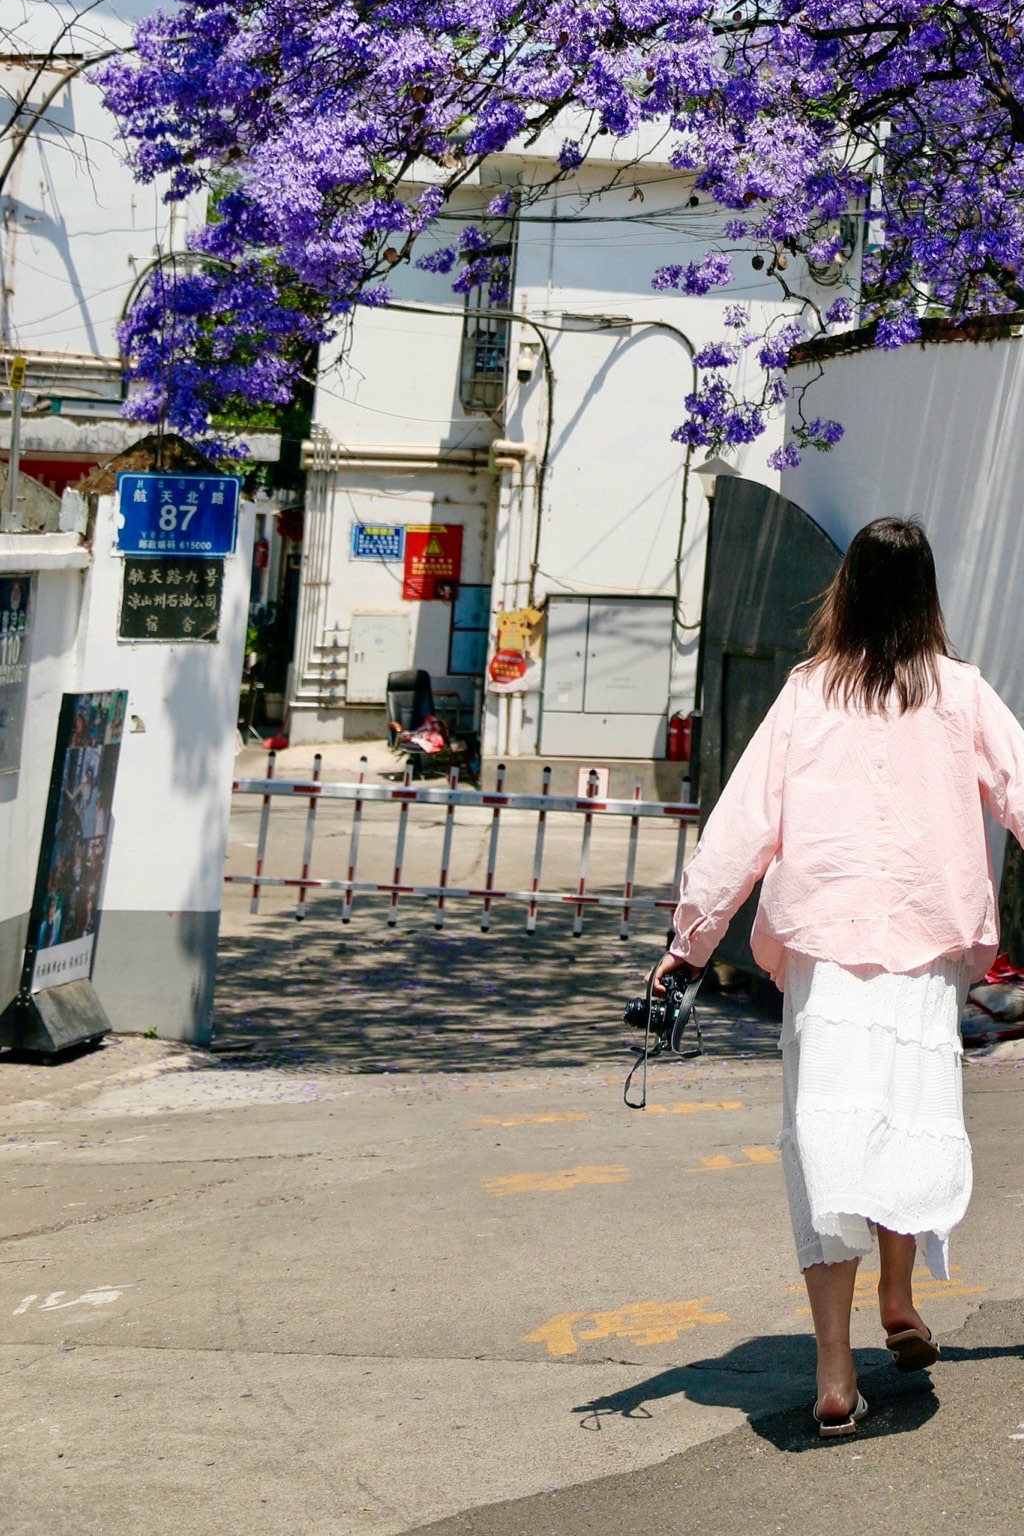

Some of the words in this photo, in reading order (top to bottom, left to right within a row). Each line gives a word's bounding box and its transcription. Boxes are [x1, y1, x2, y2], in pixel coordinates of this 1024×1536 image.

[133, 489, 225, 505] 航天北路
[159, 505, 198, 531] 87
[128, 568, 218, 587] 航天路九号
[128, 592, 217, 610] 凉山州石油公司
[146, 614, 196, 633] 宿舍
